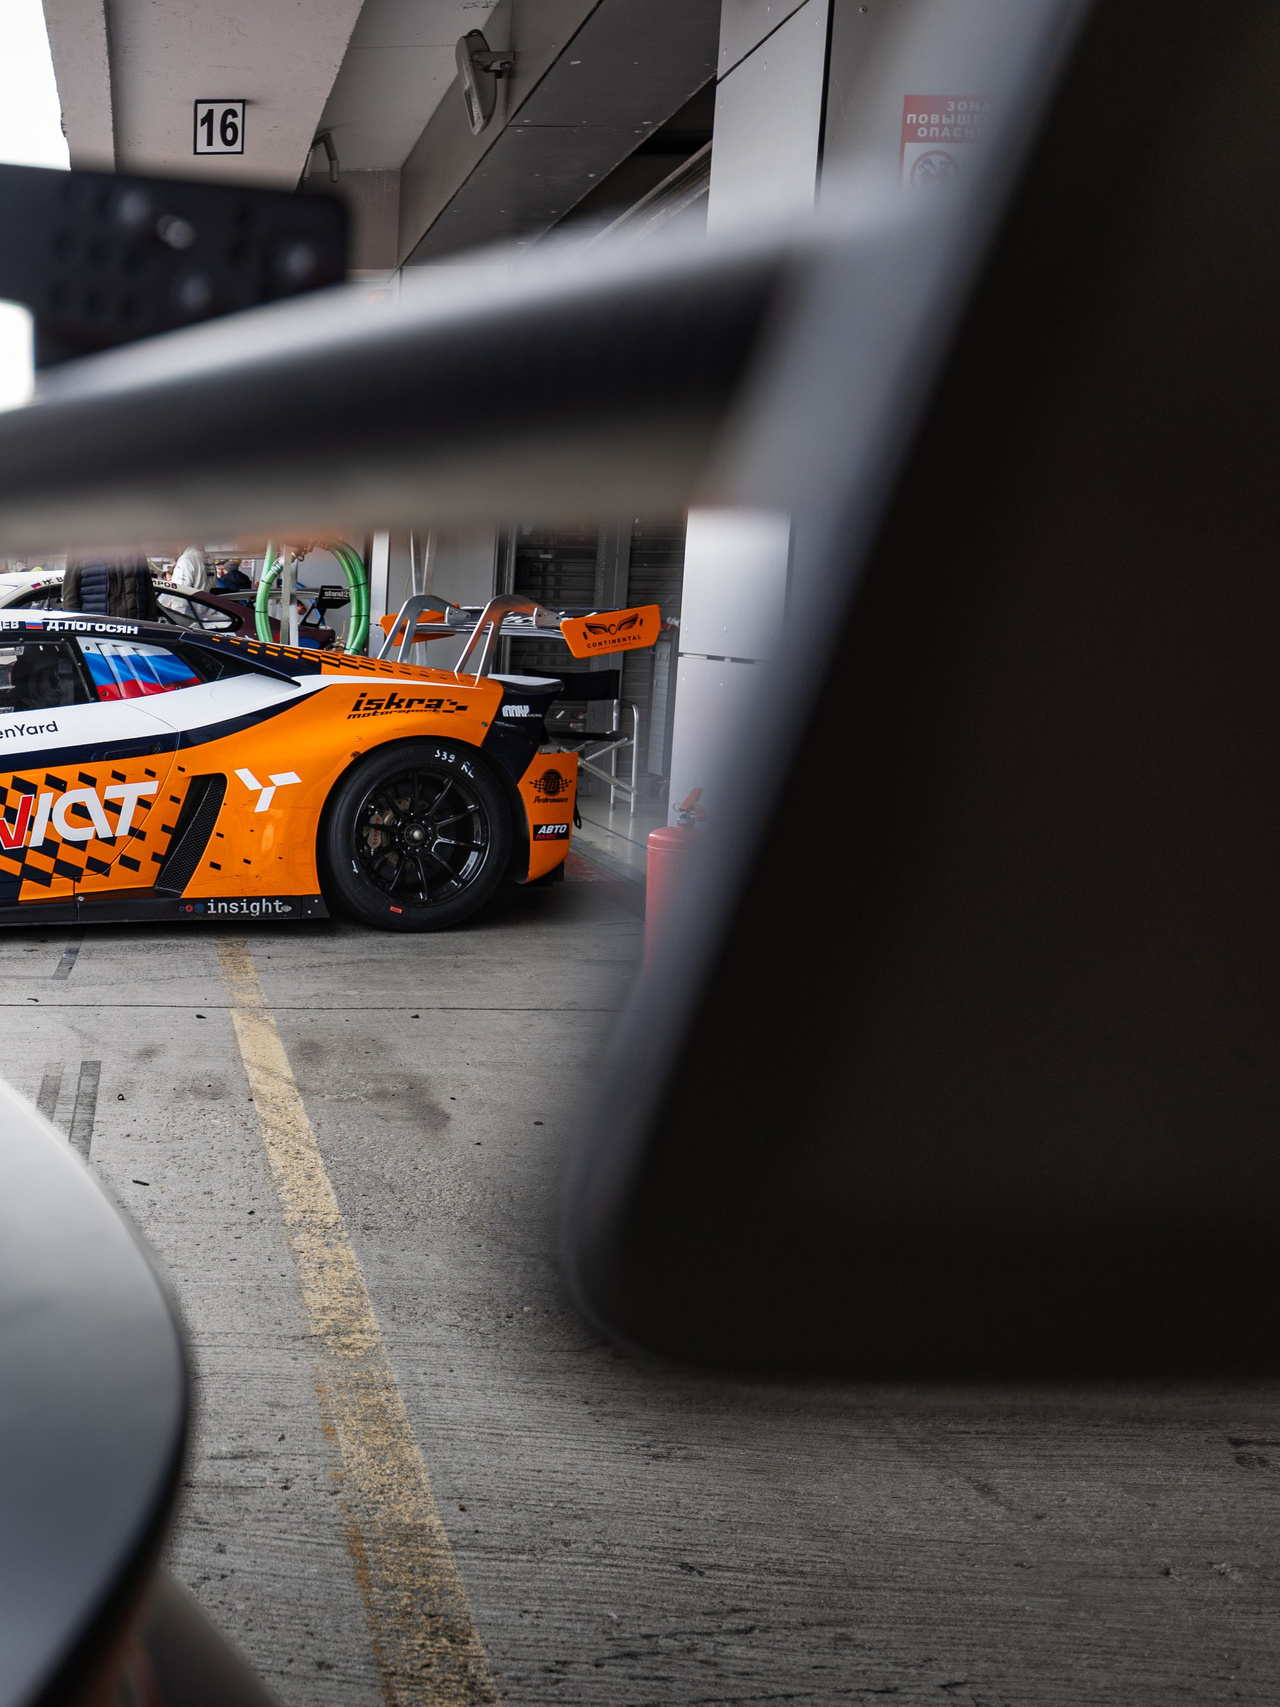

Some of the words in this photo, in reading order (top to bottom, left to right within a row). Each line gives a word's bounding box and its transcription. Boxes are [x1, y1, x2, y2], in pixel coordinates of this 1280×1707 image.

[200, 108, 239, 147] 16
[46, 620, 139, 635] Д.ПОГОСЯН
[587, 635, 641, 649] CONTINENTAL
[351, 692, 445, 712] iskra
[347, 708, 440, 719] motorsport
[538, 824, 568, 834] АВТО
[207, 898, 283, 917] insight
